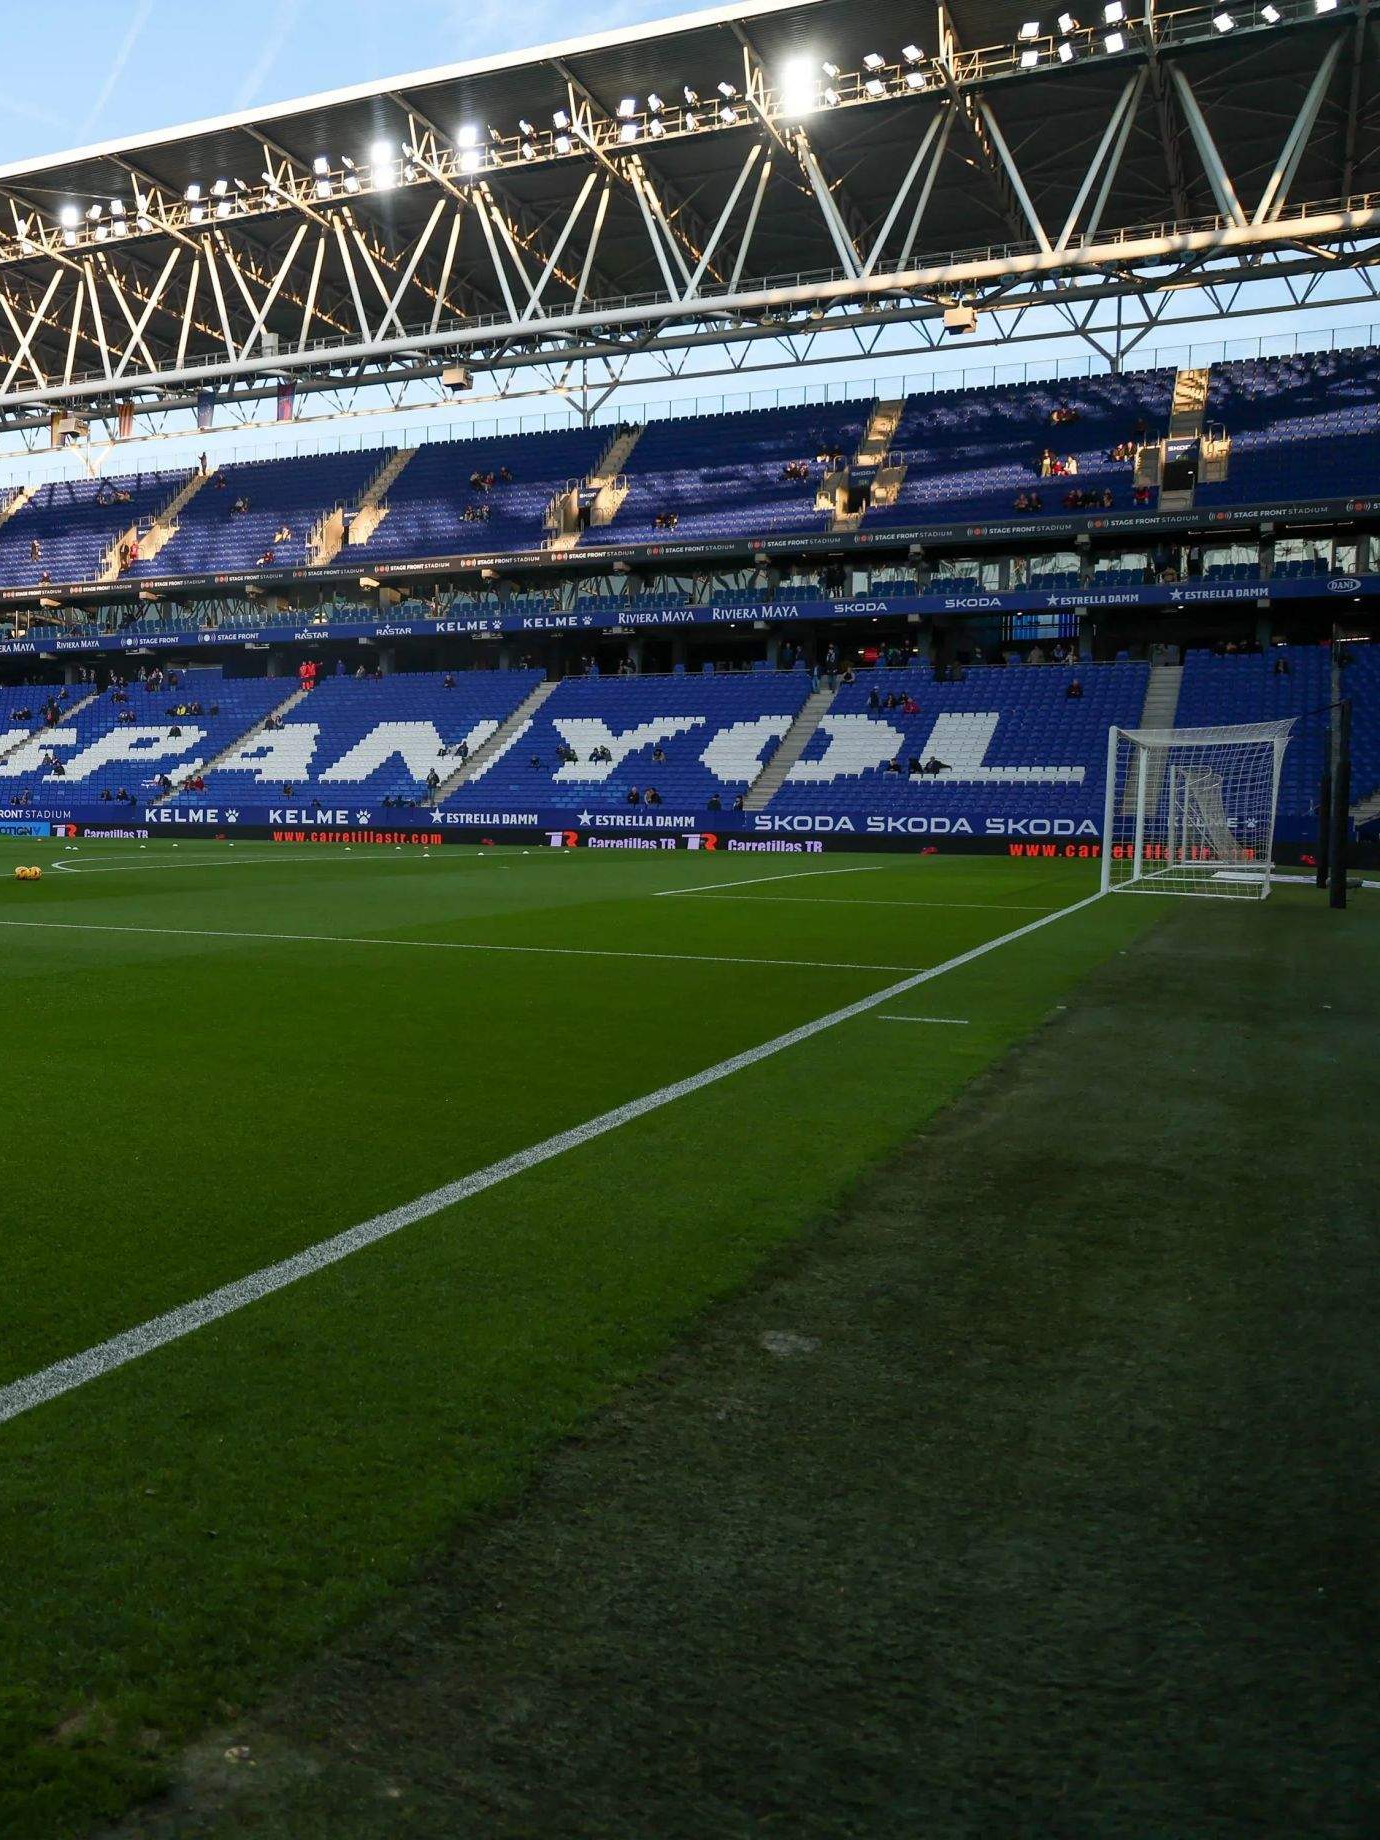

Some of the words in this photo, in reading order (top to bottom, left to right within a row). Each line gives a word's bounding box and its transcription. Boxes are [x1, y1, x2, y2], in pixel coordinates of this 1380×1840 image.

[1185, 589, 1234, 599] ESTRELLA
[1236, 588, 1268, 597] DAMM
[1060, 595, 1106, 605] ESTRELLA
[1108, 594, 1138, 603] DAMM
[436, 621, 488, 632] KELME
[524, 617, 577, 627] KELME
[295, 631, 328, 640] RASTAR
[376, 627, 412, 636] RASTAR
[25, 810, 71, 819] STADIUM
[145, 809, 218, 823] KELME
[269, 810, 349, 824] KELME
[446, 813, 500, 824] ESTRELLA
[502, 814, 538, 825] DAMM
[595, 815, 653, 826] ESTRELLA
[655, 815, 695, 827] DAMM
